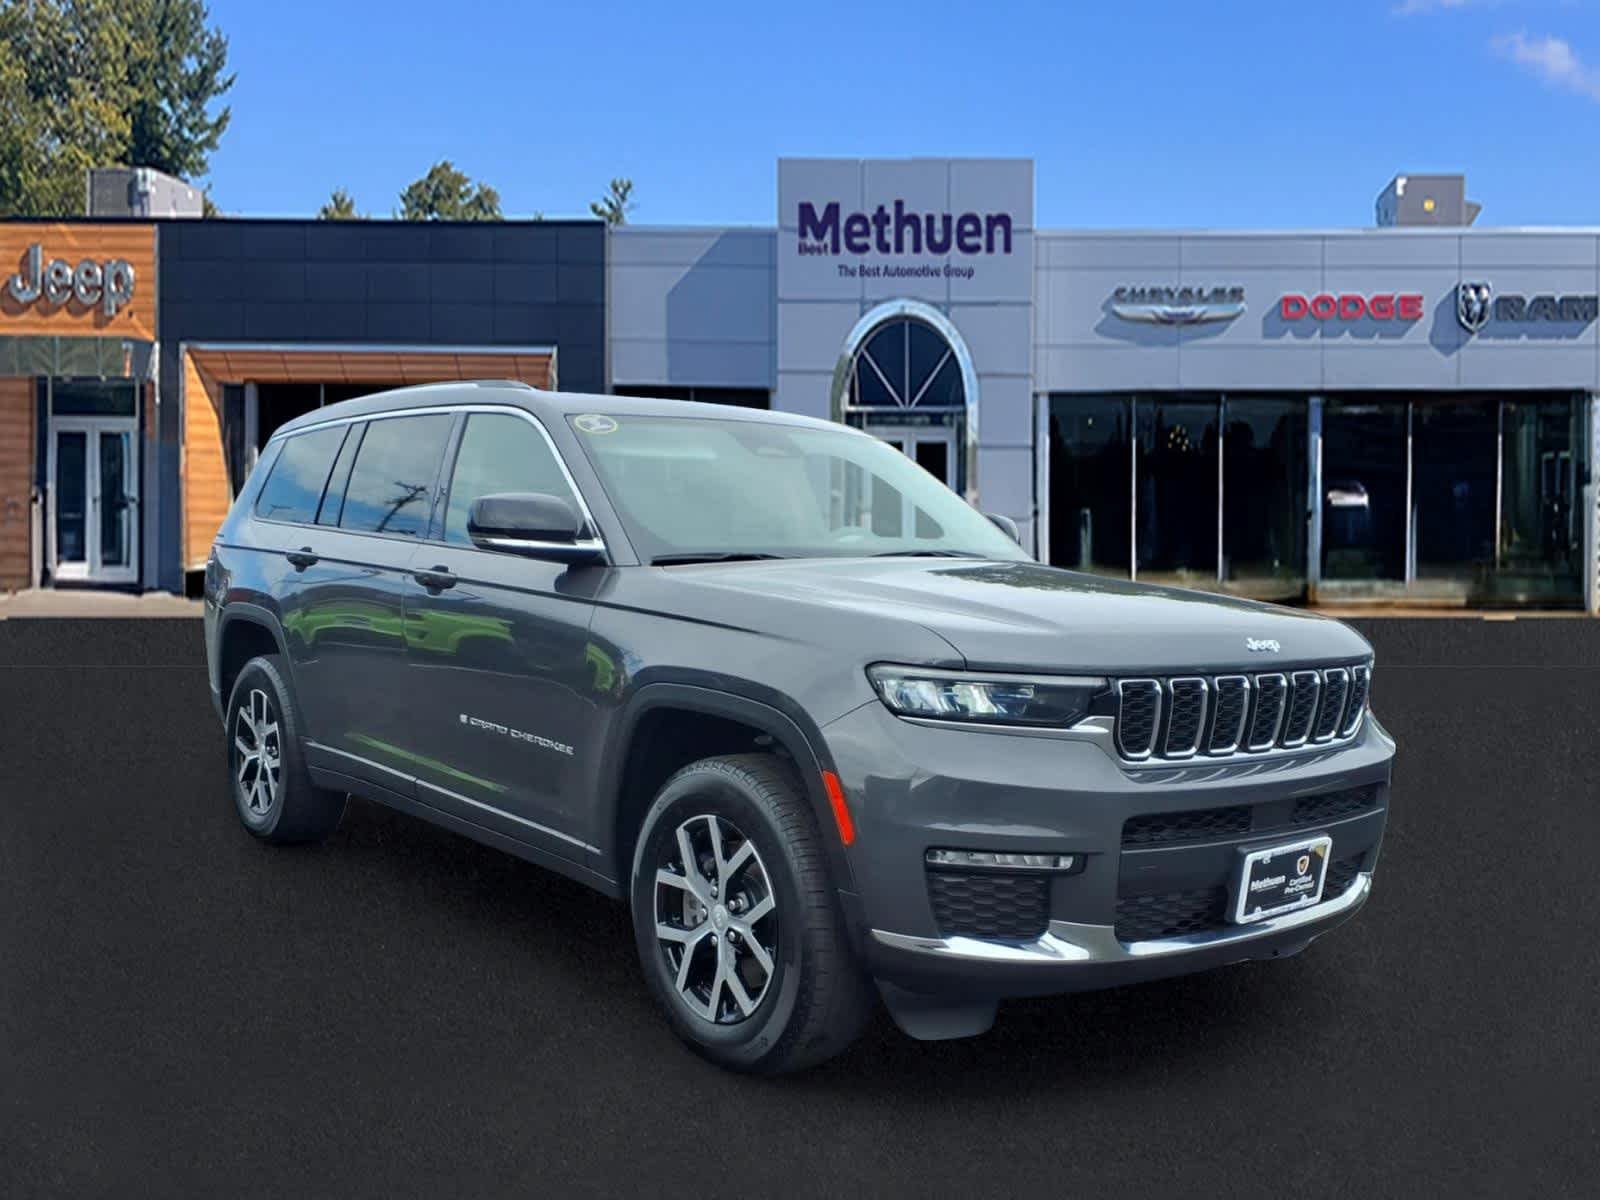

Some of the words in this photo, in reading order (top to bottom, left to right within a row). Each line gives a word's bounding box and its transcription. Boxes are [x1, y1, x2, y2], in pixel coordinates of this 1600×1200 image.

[798, 199, 1012, 255] Methuen
[798, 241, 829, 256] Best
[9, 242, 135, 317] Jeep
[837, 264, 857, 277] The
[858, 264, 880, 277] Best
[882, 264, 941, 277] Automotive
[943, 264, 975, 280] Group
[1113, 287, 1245, 302] CHRYSLER
[1281, 294, 1424, 320] DODGE
[1494, 295, 1599, 321] RAM
[1246, 637, 1281, 653] Jeep
[510, 728, 575, 756] CHEROKEE
